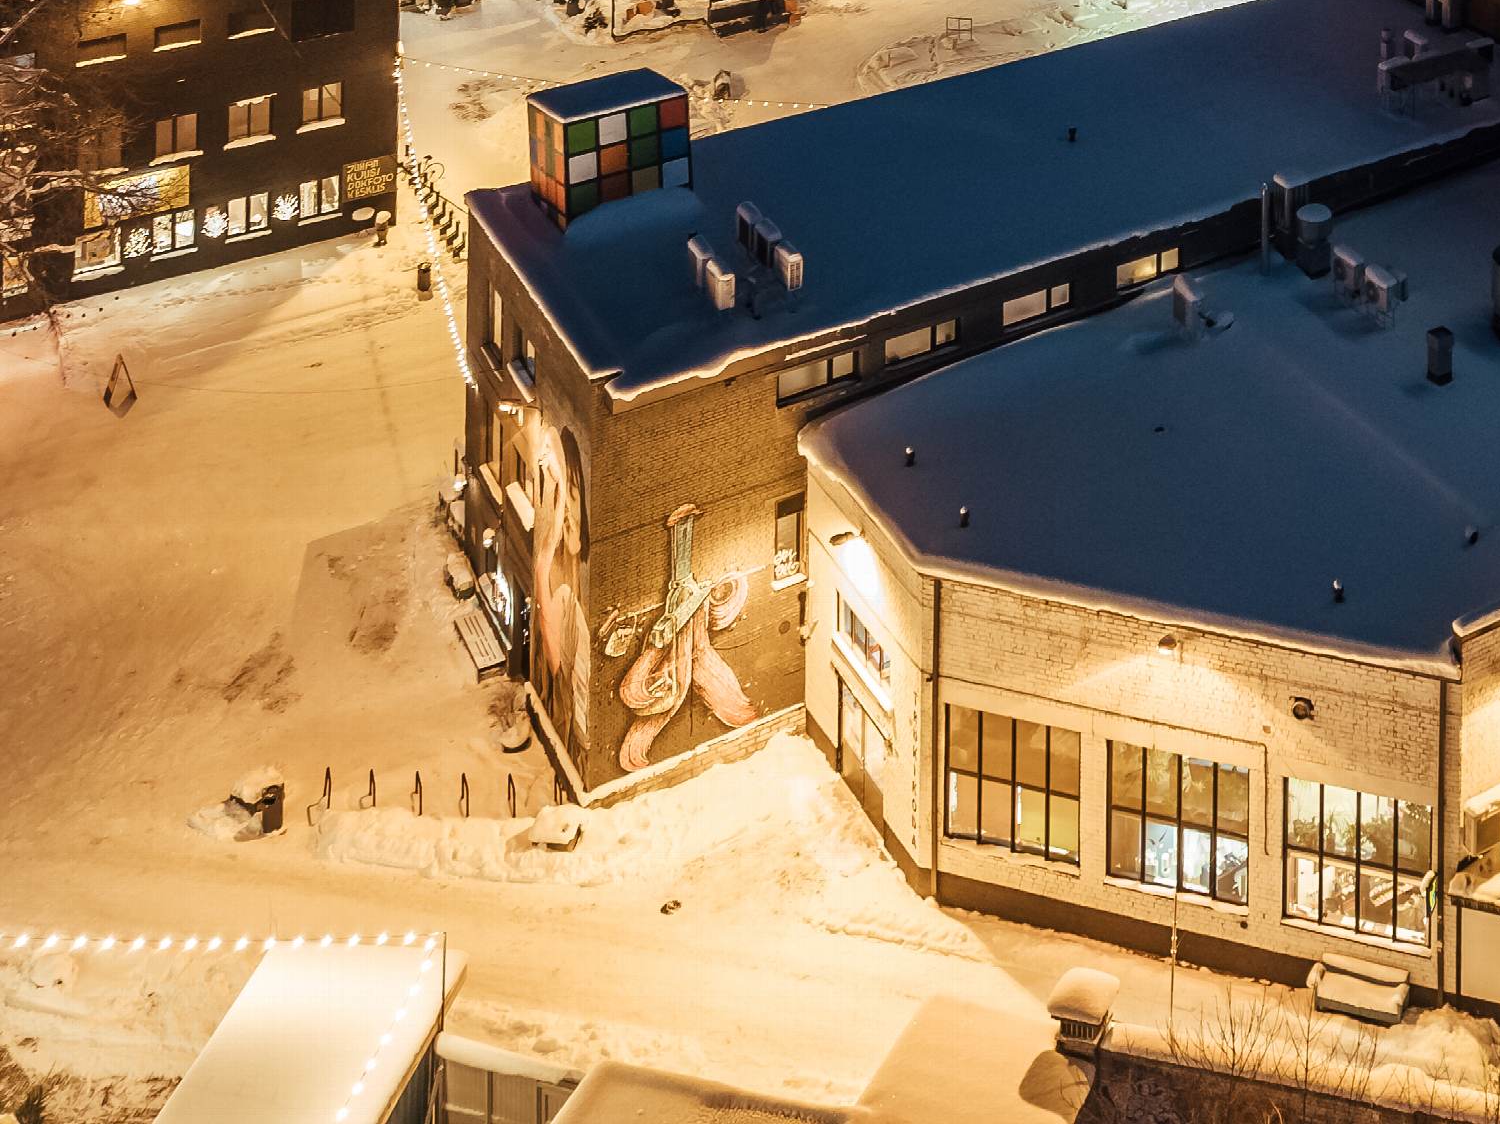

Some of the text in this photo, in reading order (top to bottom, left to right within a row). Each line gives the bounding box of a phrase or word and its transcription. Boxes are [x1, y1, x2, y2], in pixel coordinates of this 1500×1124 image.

[347, 168, 381, 182] KUUSI
[347, 173, 394, 190] DOKFOTO
[347, 183, 386, 198] KESKUS
